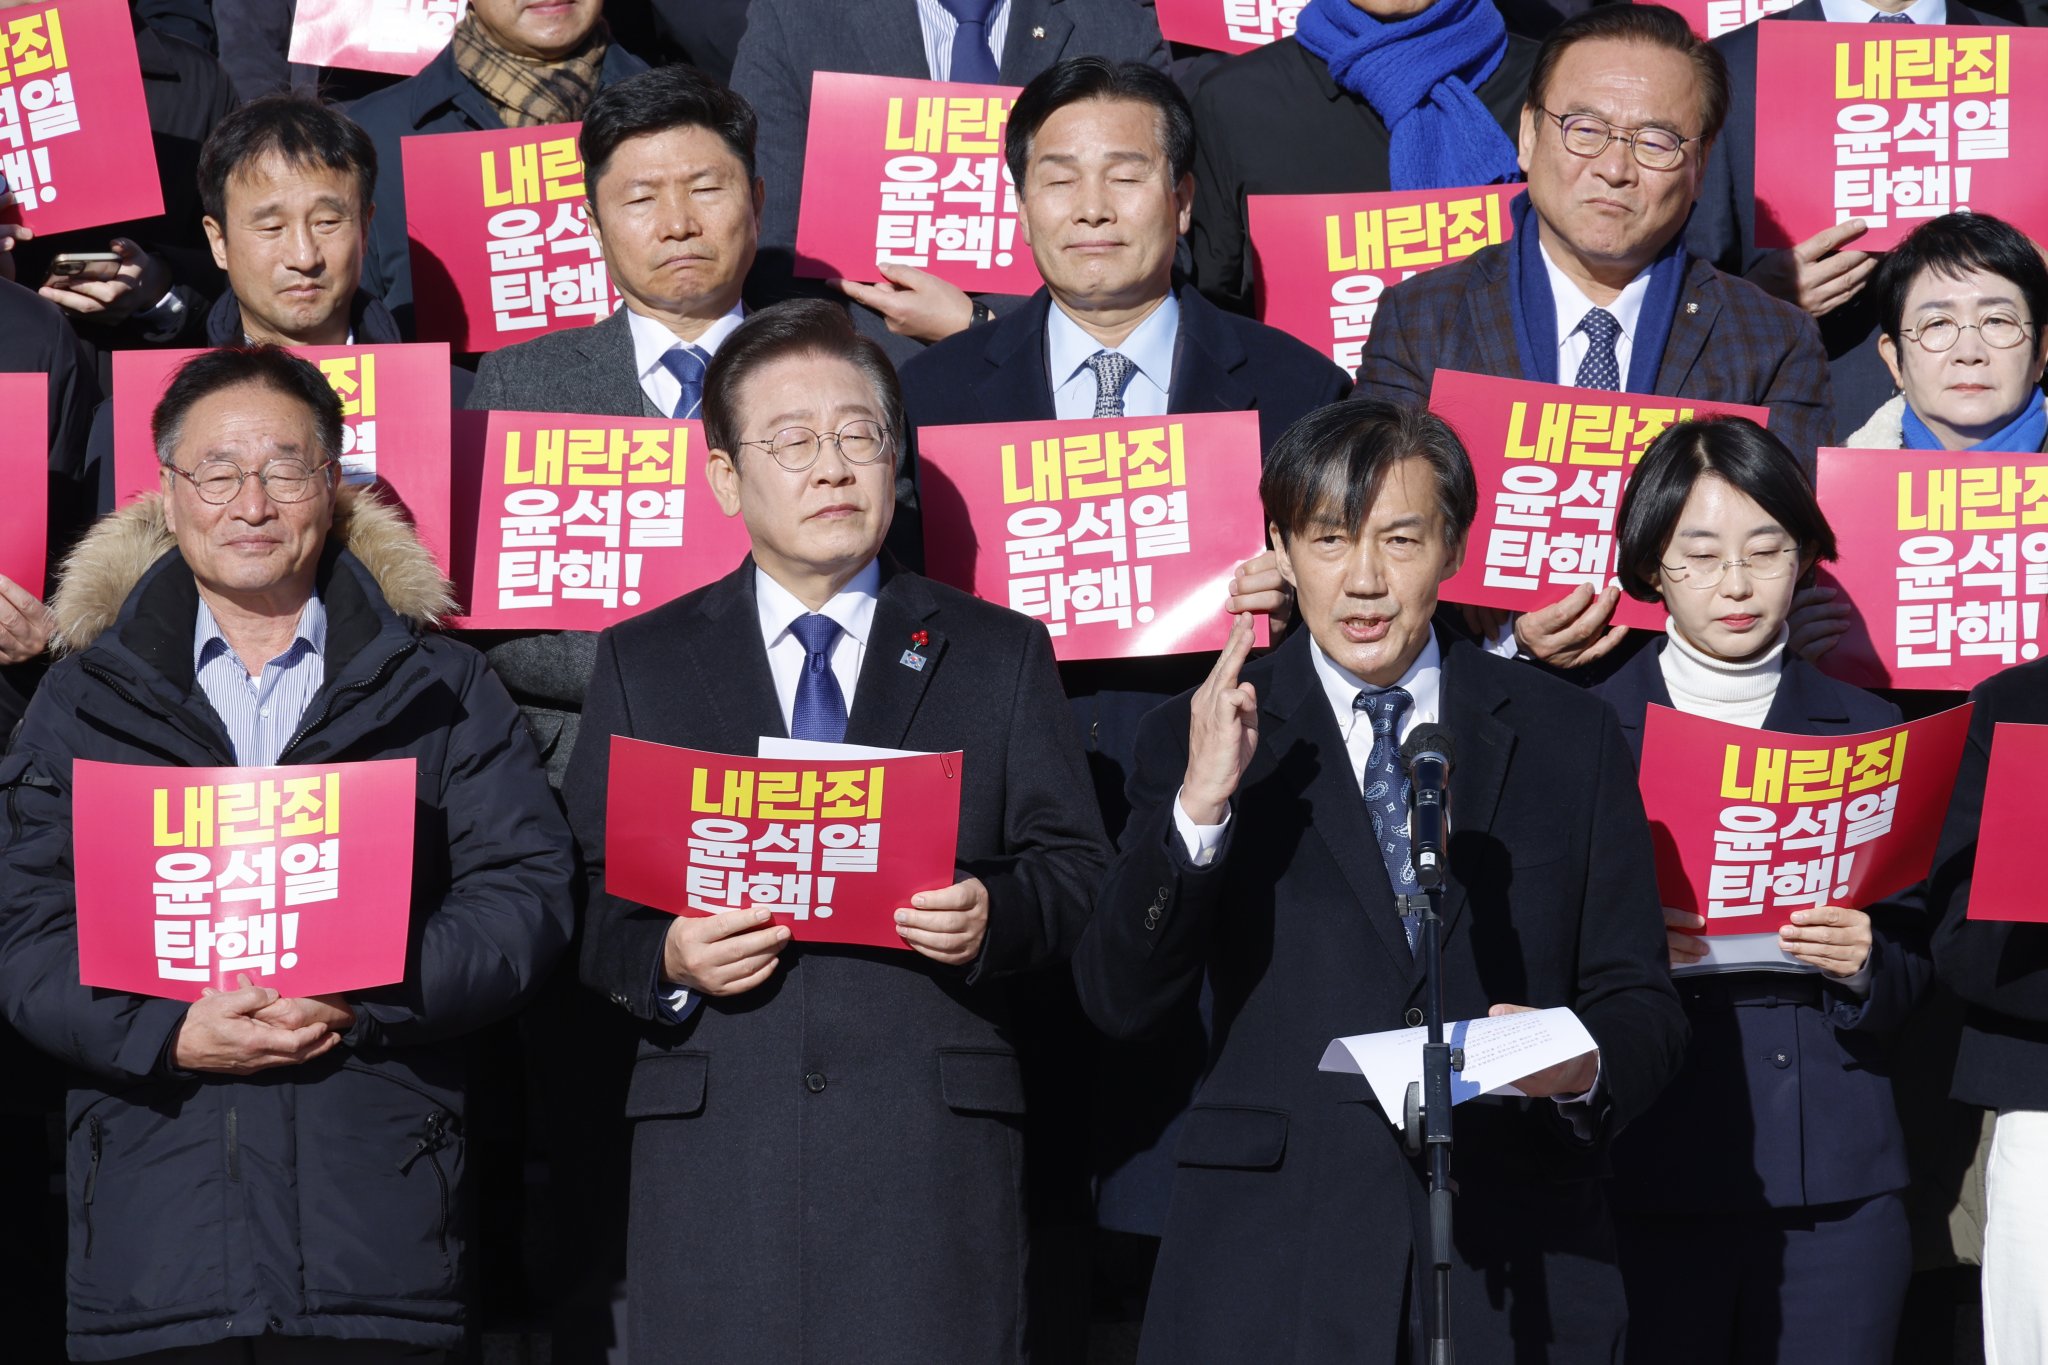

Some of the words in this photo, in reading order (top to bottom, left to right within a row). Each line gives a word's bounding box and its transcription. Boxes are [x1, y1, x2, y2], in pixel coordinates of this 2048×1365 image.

[0, 8, 68, 84] 죄
[1835, 35, 2010, 99] 내란죄
[884, 97, 1021, 154] 내란
[1834, 99, 2009, 166] 윤석열
[1834, 165, 1972, 224] 탄핵!
[875, 214, 1017, 269] 탄핵!
[1325, 193, 1503, 273] 내란죄
[490, 260, 624, 332] 탄핵
[503, 427, 689, 486] 내란죄
[1001, 423, 1187, 505] 내란죄
[500, 488, 686, 548] 윤석열
[1495, 465, 1629, 531] 윤석
[1005, 490, 1191, 575] 윤석열
[497, 549, 643, 610] 탄핵!
[1008, 564, 1155, 638] 탄핵!
[1896, 600, 2040, 668] 탄핵!
[691, 766, 885, 820] 내란죄
[1720, 730, 1909, 804] 내란죄
[153, 772, 339, 847] 내란죄
[1713, 784, 1900, 861] 윤석열
[152, 838, 339, 916] 윤석열
[687, 818, 881, 873] 윤석열
[686, 865, 836, 920] 탄핵!
[1707, 851, 1856, 919] 탄핵!
[154, 912, 299, 982] 탄핵!
